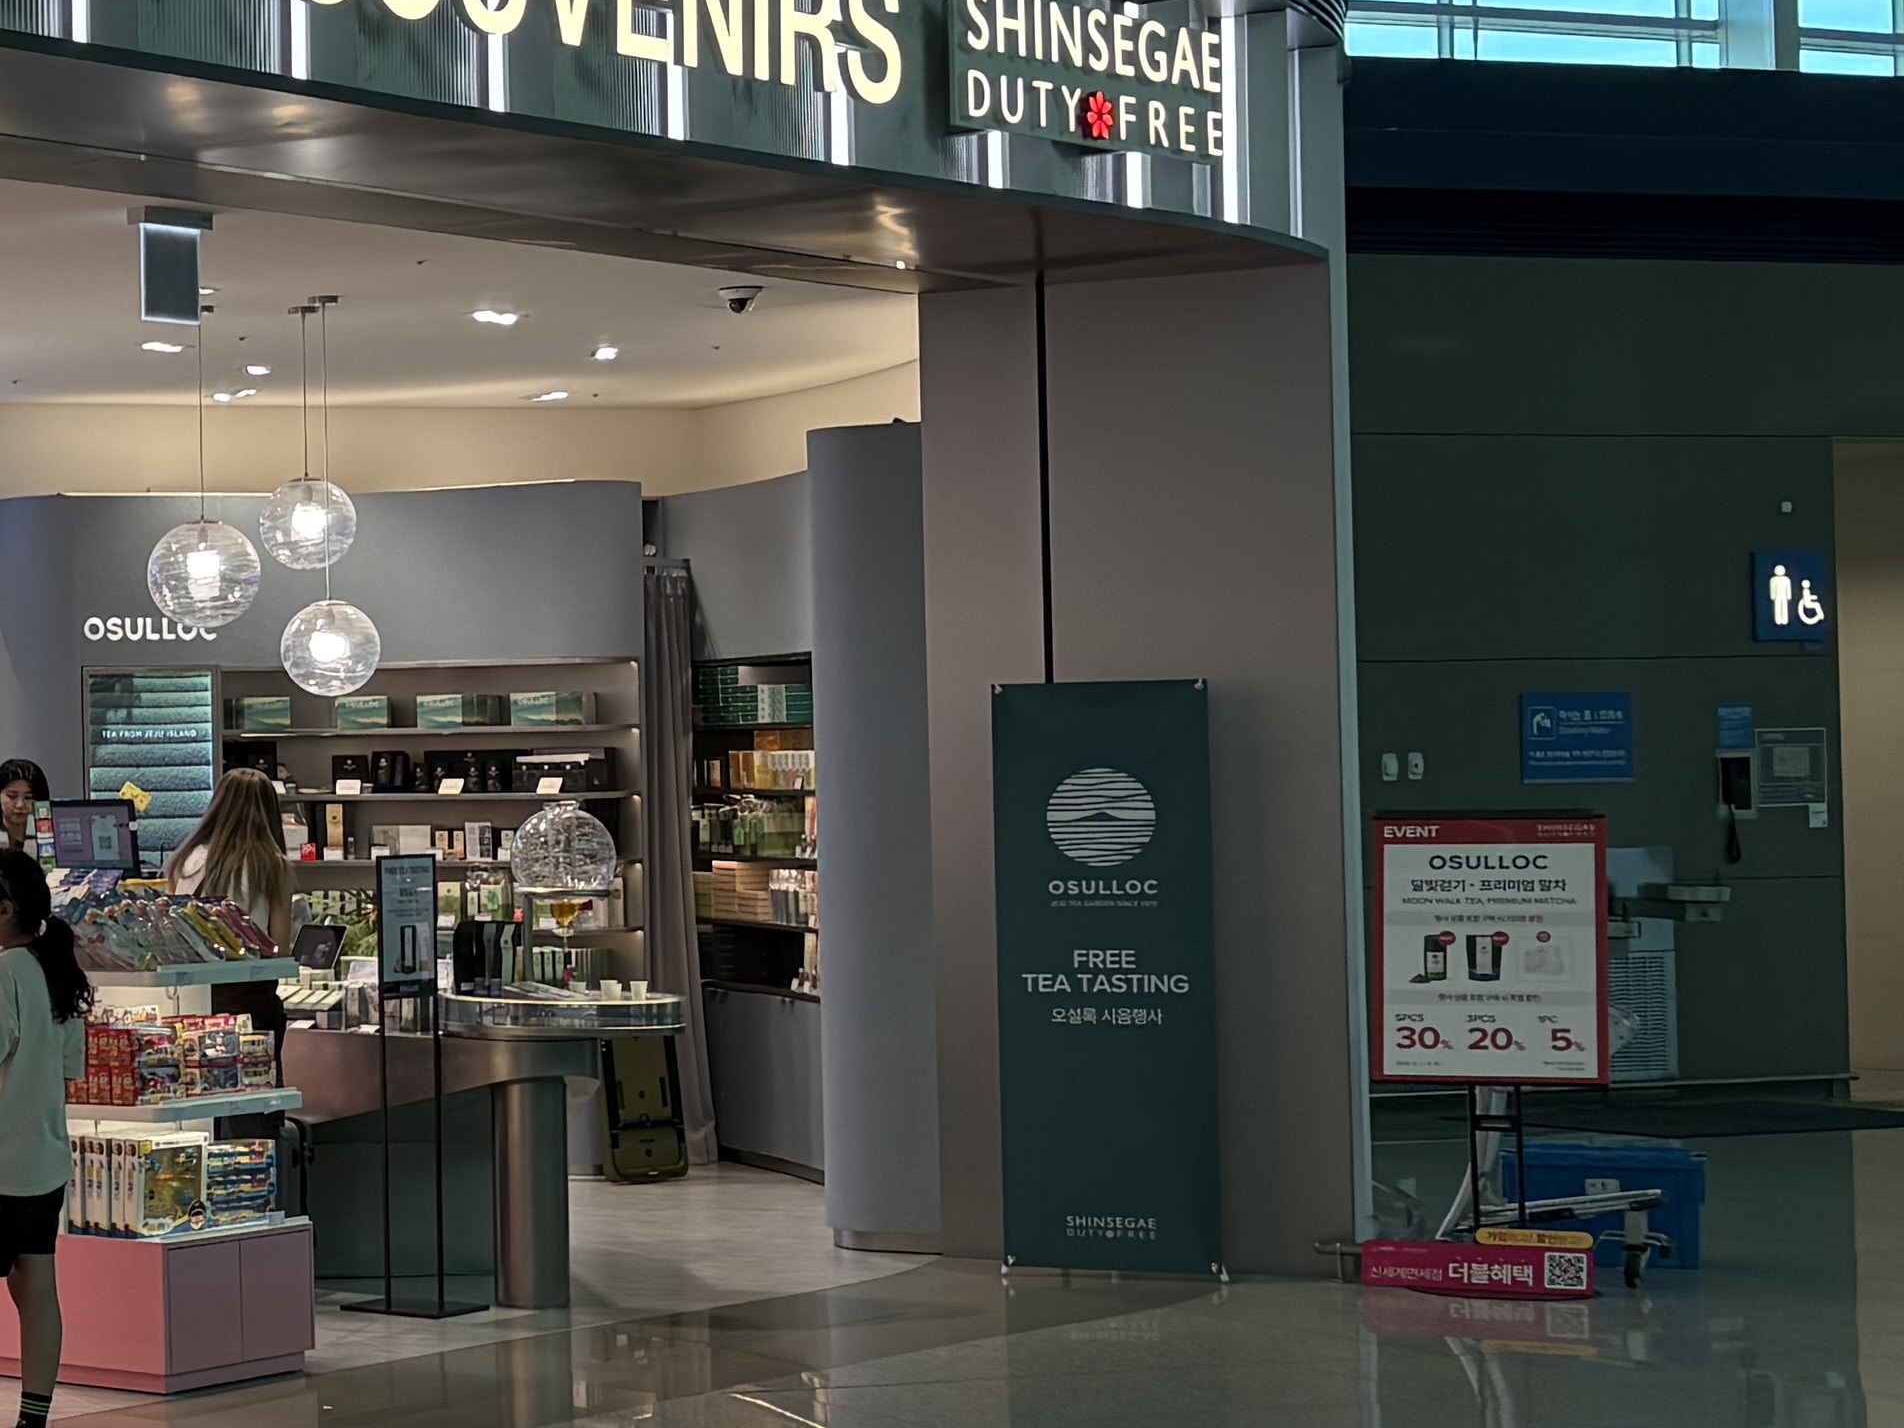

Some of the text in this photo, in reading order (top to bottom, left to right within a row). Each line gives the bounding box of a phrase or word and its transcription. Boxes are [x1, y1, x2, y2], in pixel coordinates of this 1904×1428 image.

[967, 69, 1224, 158] DUTY FREE
[84, 616, 217, 641] OSULLOC
[102, 729, 116, 738] TEA
[1384, 825, 1439, 838] EVENT
[1428, 854, 1549, 870] OSULLOC
[1048, 879, 1159, 895] OSULLOC
[1479, 878, 1535, 892] 프리미엄
[1073, 949, 1136, 969] FREE
[1021, 974, 1190, 994] TEA TASTING
[1051, 1007, 1163, 1025] 오설록 시음행사
[1066, 1215, 1157, 1230] SHINSEGAE
[1448, 1261, 1534, 1286] 더블혜택
